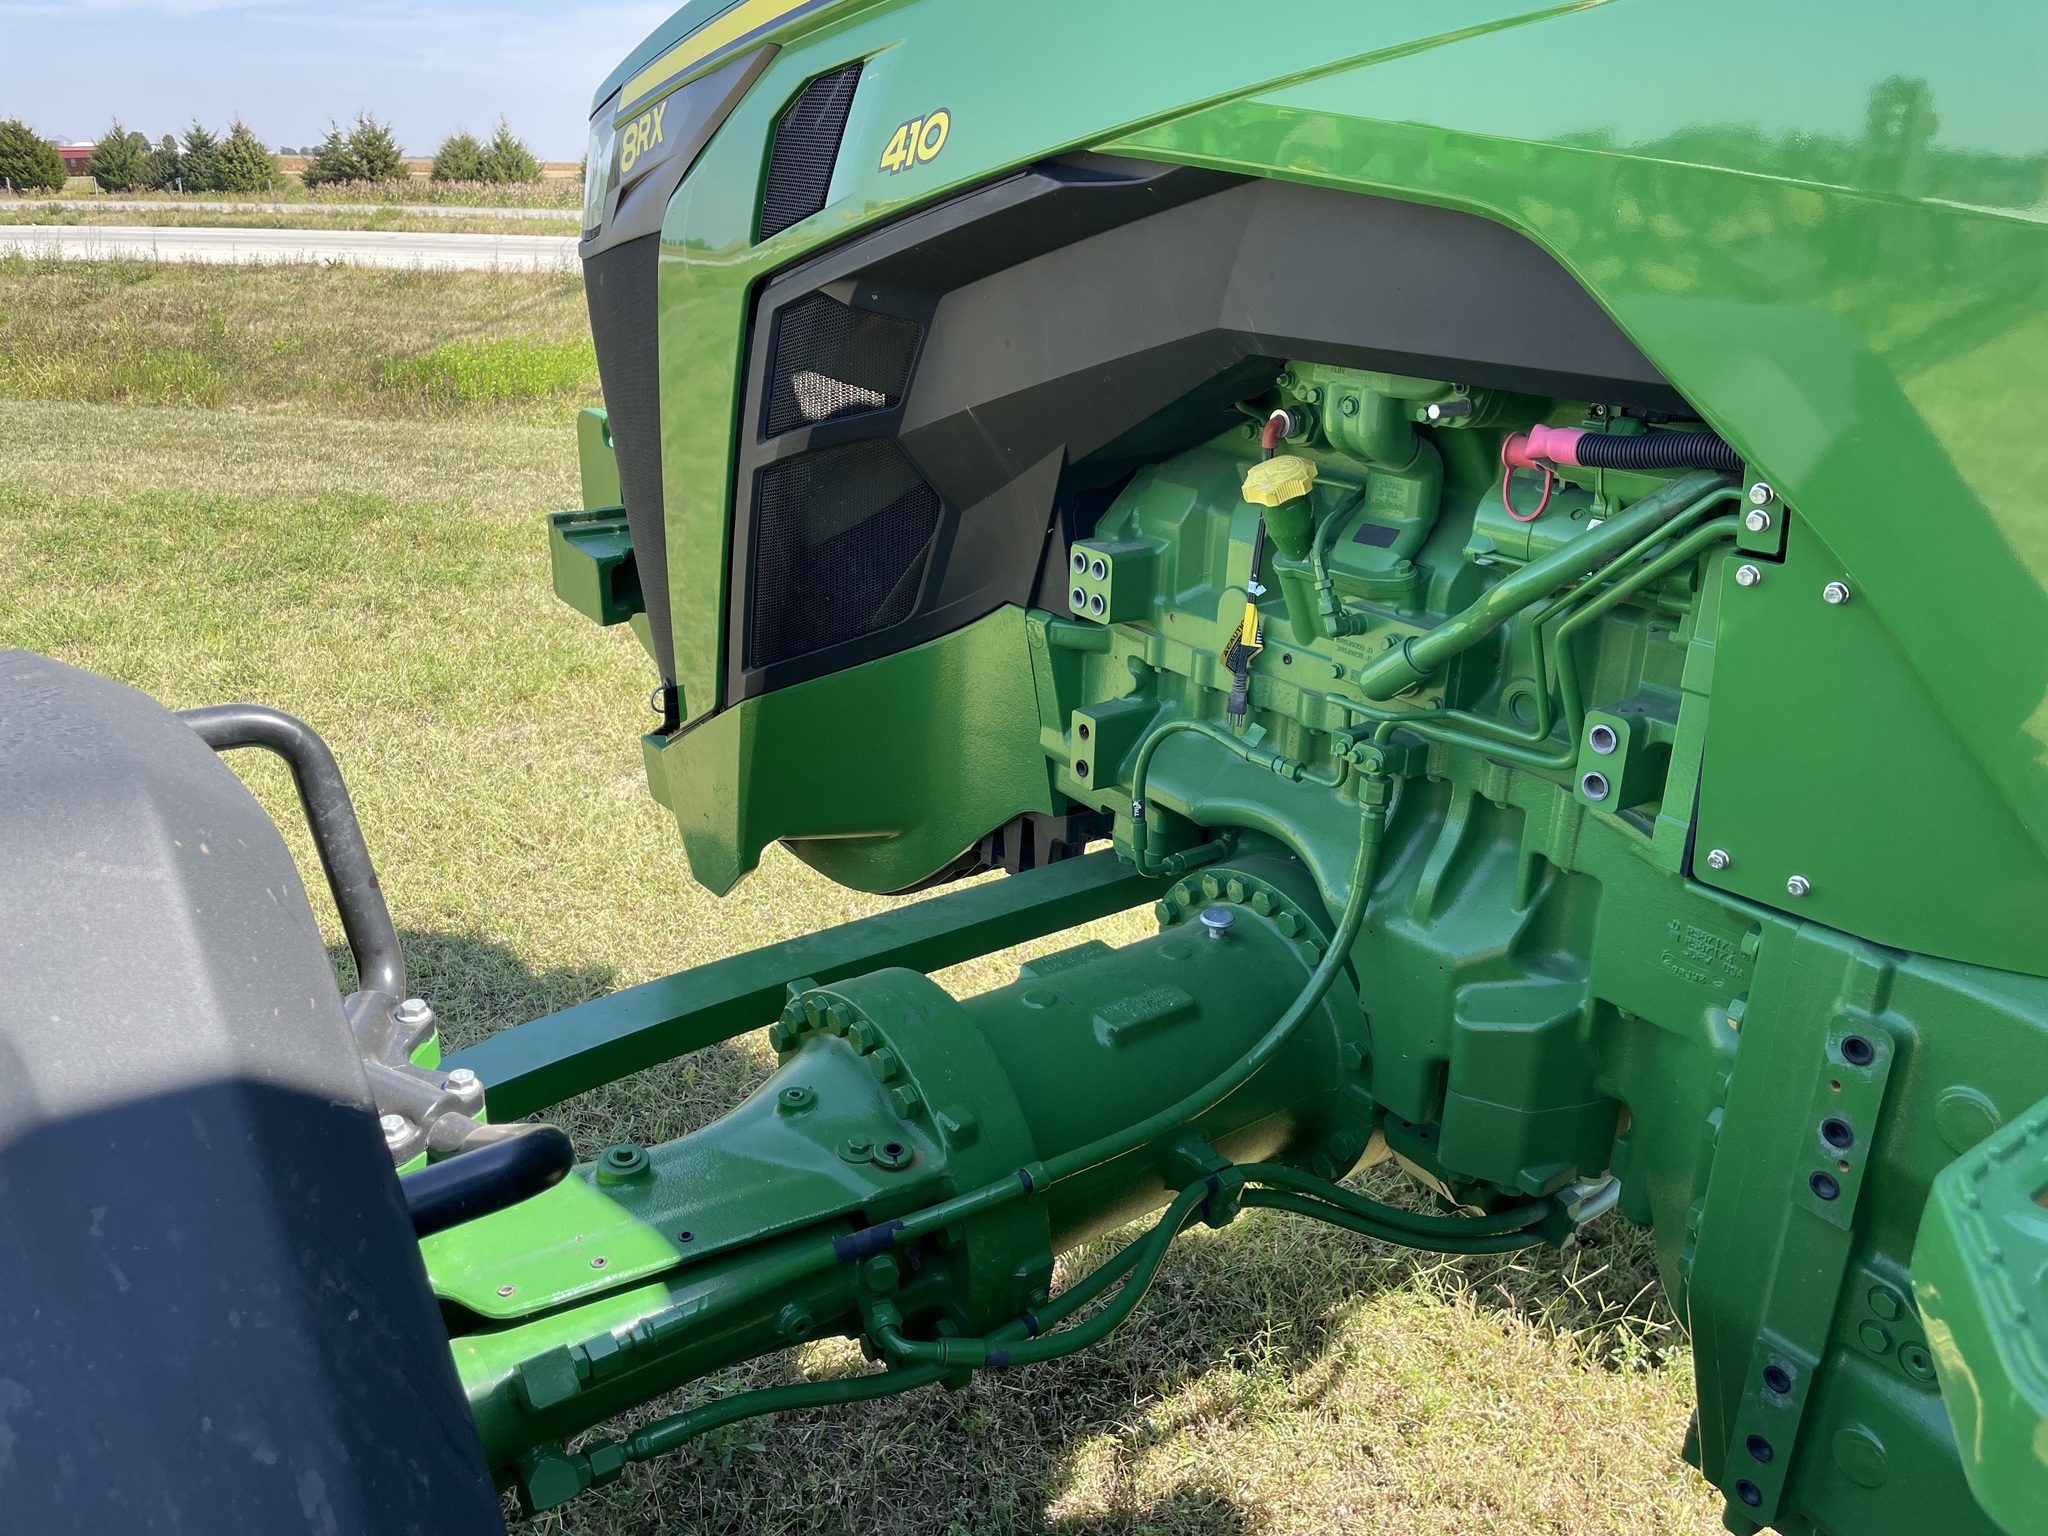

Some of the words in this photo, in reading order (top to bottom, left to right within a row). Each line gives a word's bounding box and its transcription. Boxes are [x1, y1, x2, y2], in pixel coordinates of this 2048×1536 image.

[620, 101, 667, 173] 8RX
[879, 108, 951, 175] 410
[1226, 619, 1245, 650] CAUTIO
